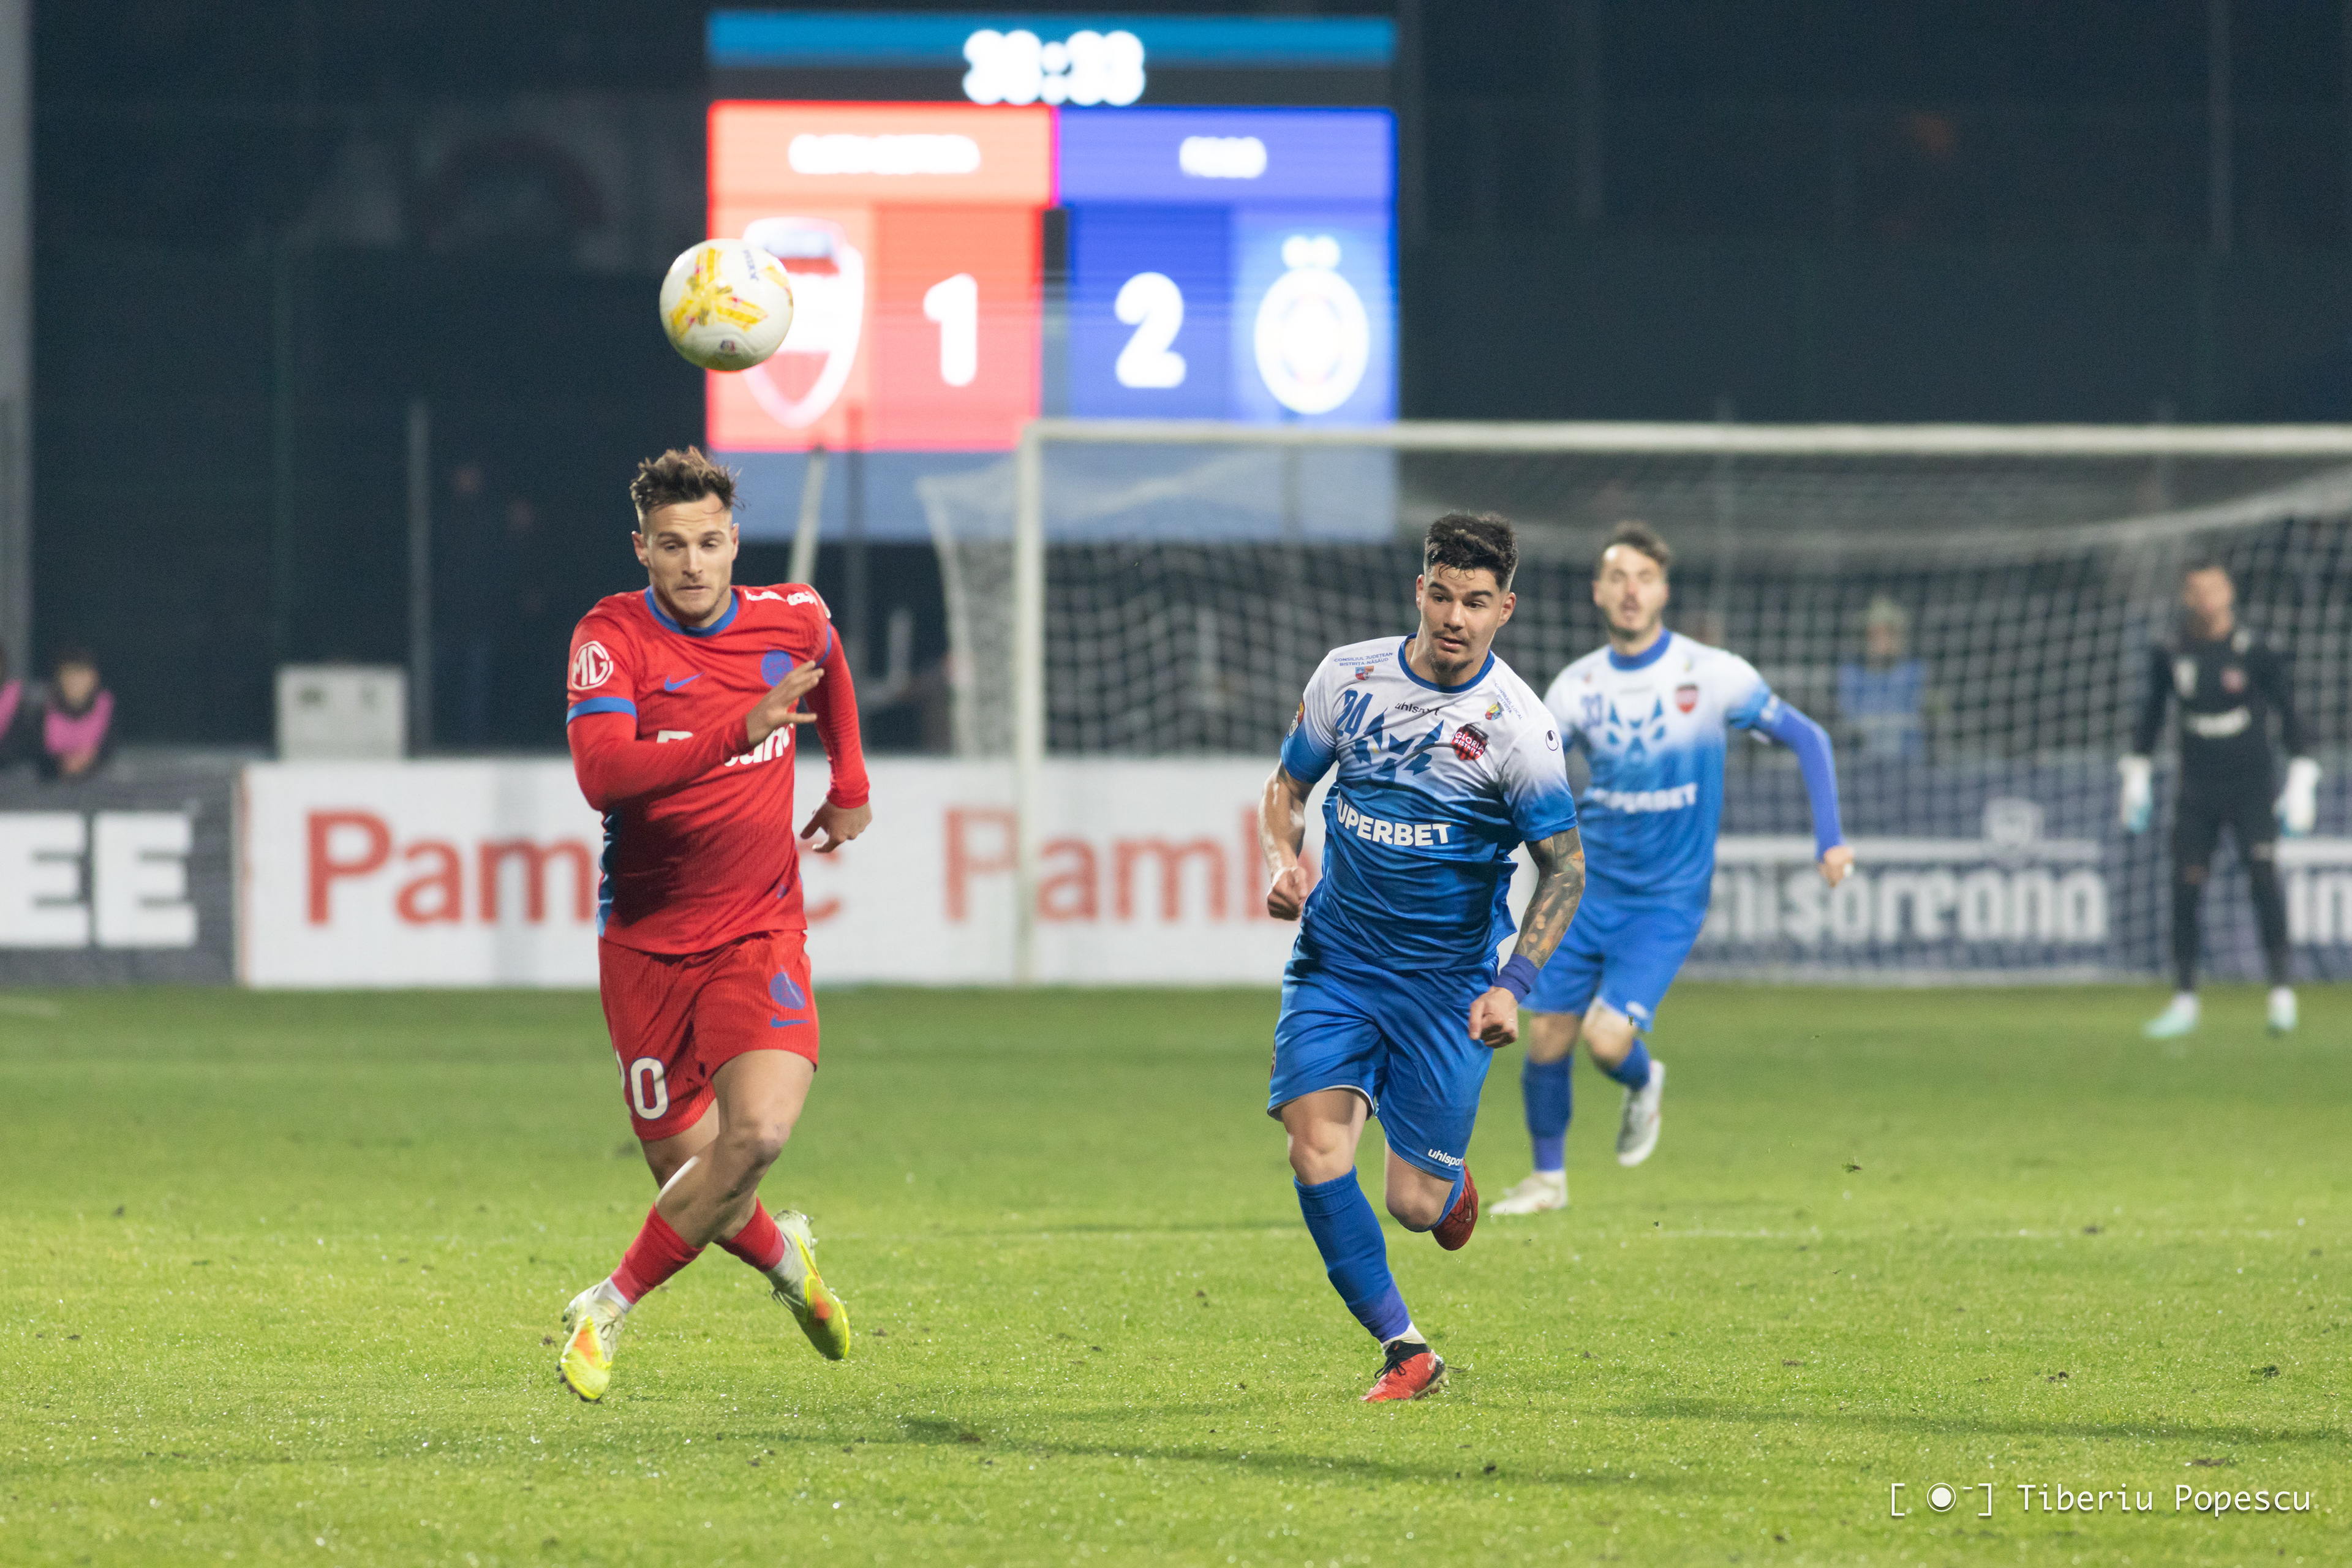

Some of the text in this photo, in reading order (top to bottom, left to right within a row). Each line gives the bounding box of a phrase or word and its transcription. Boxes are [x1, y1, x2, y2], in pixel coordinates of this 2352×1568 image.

[924, 273, 979, 386] 1
[1115, 272, 1187, 388] 2
[572, 644, 608, 687] MG
[1494, 683, 1523, 720] CONSILIUL LOCAL
[1455, 731, 1484, 752] GLORIA
[1336, 790, 1452, 846] UPERBET
